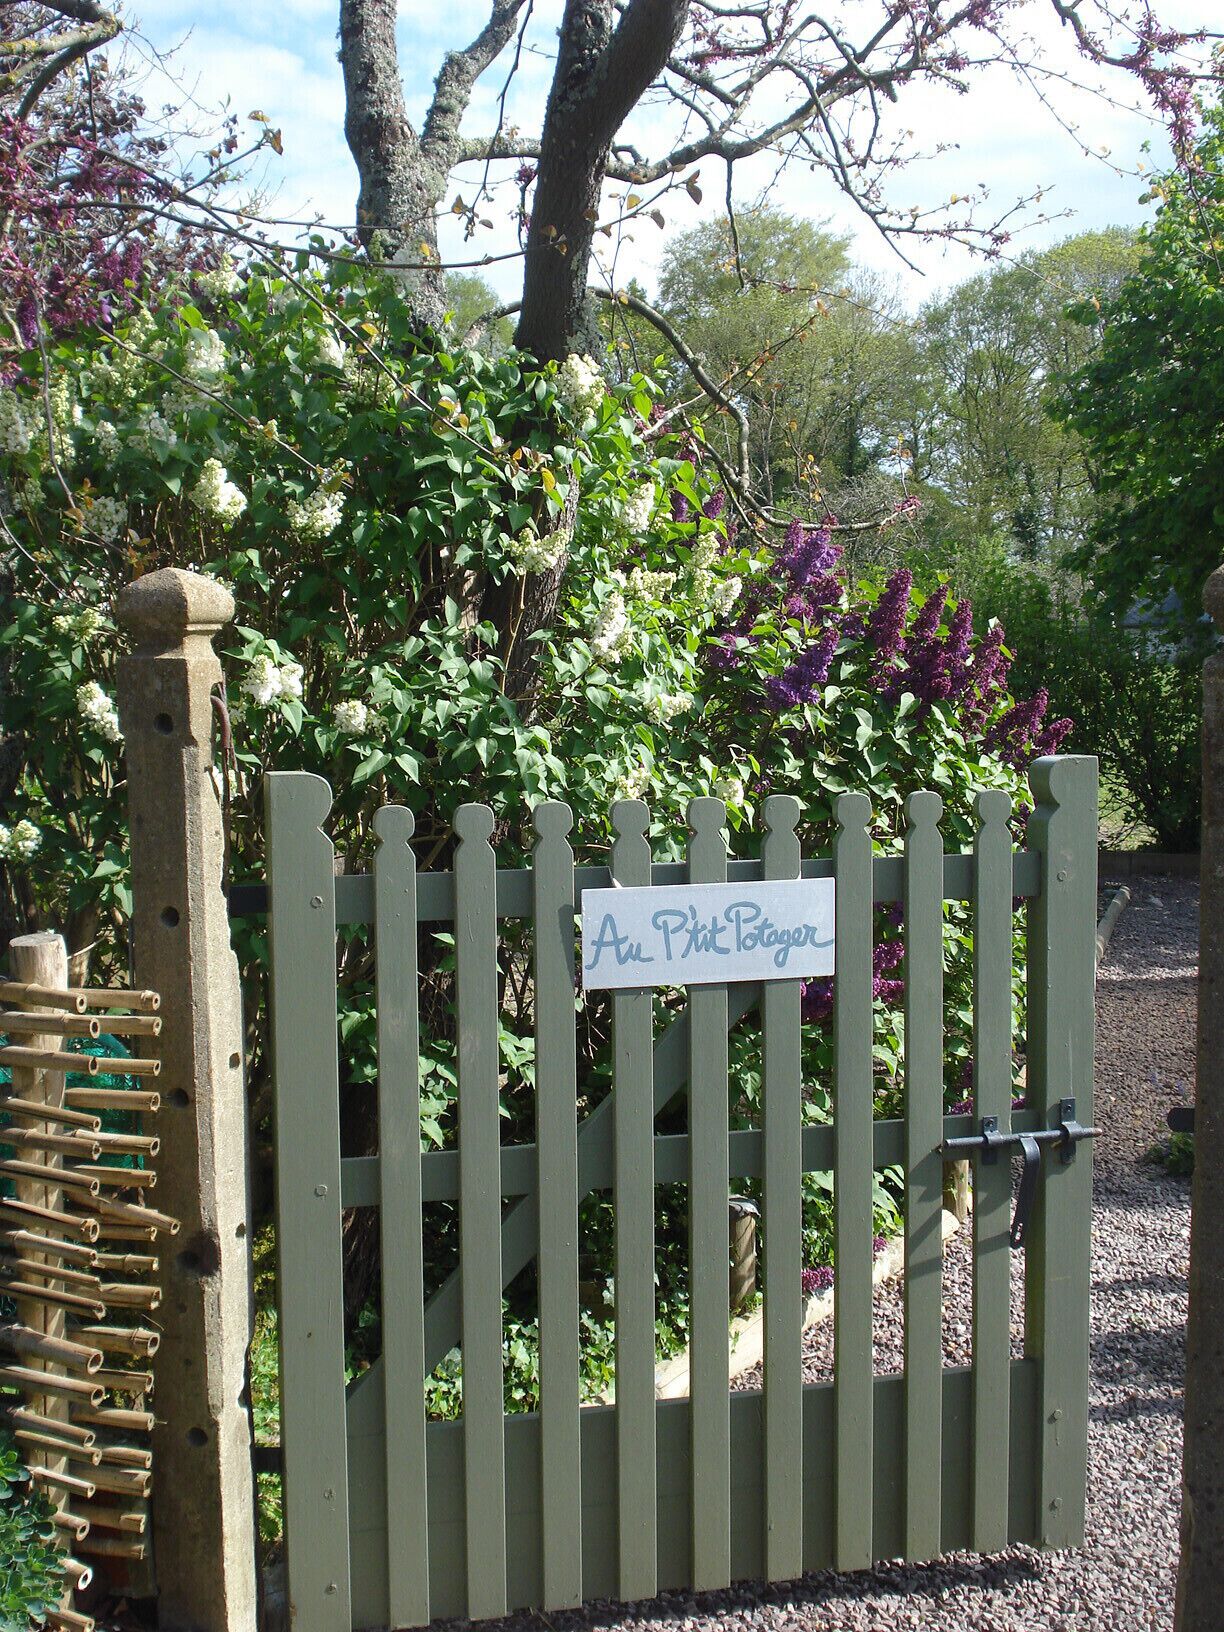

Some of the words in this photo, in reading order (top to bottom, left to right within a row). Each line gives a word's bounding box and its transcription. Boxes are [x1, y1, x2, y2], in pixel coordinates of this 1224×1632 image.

[585, 914, 653, 970] Au
[652, 905, 730, 960] P'tit
[724, 901, 834, 967] Potager
